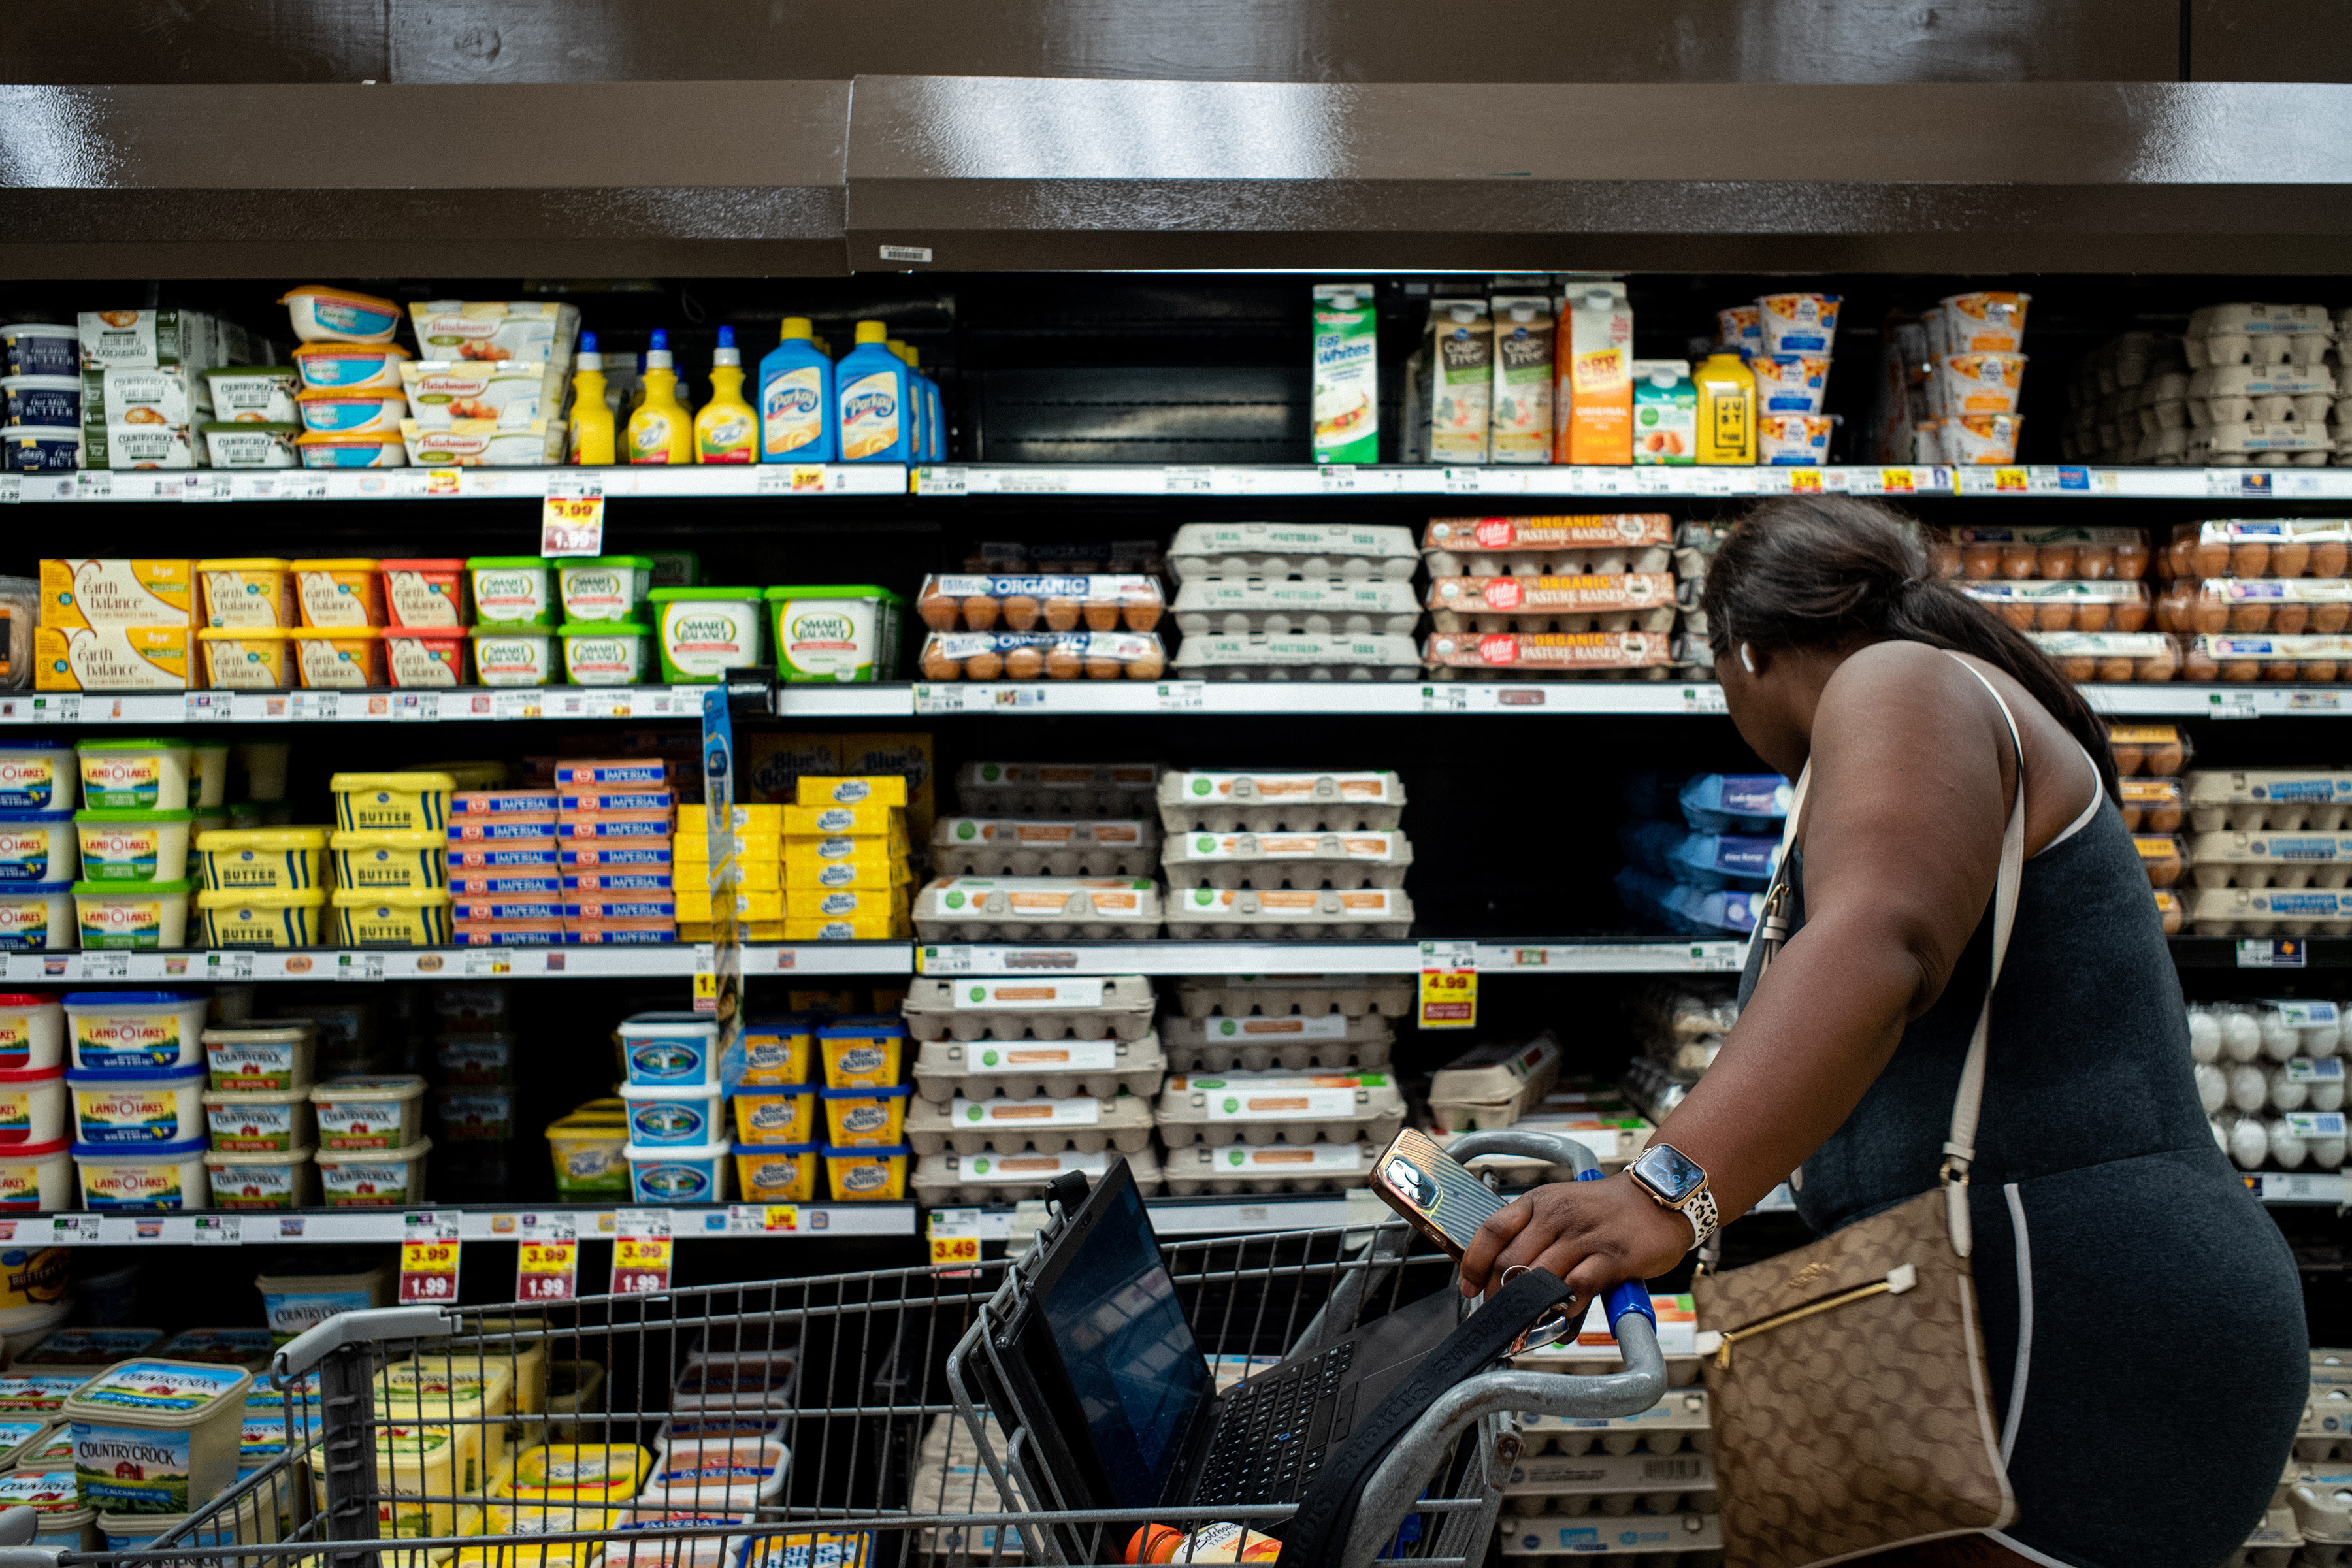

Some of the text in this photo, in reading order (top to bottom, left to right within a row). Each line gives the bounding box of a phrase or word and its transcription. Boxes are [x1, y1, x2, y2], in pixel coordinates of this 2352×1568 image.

[770, 389, 818, 416] Parkay
[845, 394, 896, 417] Parkay
[26, 406, 73, 416] BUTTER
[1531, 516, 1602, 529] ORGANIC
[1516, 528, 1617, 541] PASTURE RAISED
[488, 576, 523, 587] SMART
[576, 575, 612, 585] SMART
[1539, 576, 1610, 589] ORGANIC
[83, 581, 118, 594] earth
[214, 587, 242, 598] earth
[306, 587, 334, 598] earth
[395, 587, 424, 598] earth
[487, 585, 527, 596] BALANCE
[574, 585, 614, 595] BALANCE
[996, 578, 1086, 595] ORGANIC
[91, 595, 142, 609] balance
[1525, 589, 1626, 603] PASTURE RAISED
[221, 599, 261, 610] balance
[312, 598, 354, 610] balance
[402, 598, 444, 610] balance
[683, 620, 725, 631] SMART
[801, 619, 843, 630] SMART
[681, 629, 730, 641] BALANCE
[799, 629, 846, 640] BALANCE
[78, 649, 113, 662] earth
[86, 663, 138, 677] balance
[18, 767, 46, 779] LAKES
[87, 767, 110, 779] LAND
[127, 767, 152, 779] LAKES
[605, 768, 654, 779] IMPERIAL
[500, 798, 551, 809] IMPERIAL
[610, 795, 661, 807] IMPERIAL
[359, 811, 412, 823] BUTTER
[86, 840, 109, 850] LAND
[126, 840, 150, 851] LAKES
[610, 850, 660, 862] IMPERIAL
[223, 869, 276, 881] BUTTER
[502, 906, 551, 917] IMPERIAL
[613, 905, 662, 916] IMPERIAL
[222, 928, 274, 939] BUTTER
[359, 926, 412, 938] BUTTER
[1429, 976, 1467, 988] 4.99
[0, 1030, 16, 1041] KES
[90, 1028, 118, 1039] LAND
[137, 1028, 166, 1039] LAKES
[756, 1045, 777, 1056] Blue
[851, 1049, 873, 1060] Blue
[90, 1102, 116, 1113] LAND
[137, 1102, 163, 1113] LAKES
[761, 1106, 783, 1118] Blue
[853, 1168, 877, 1179] Blue
[0, 1179, 26, 1189] AKES
[411, 1247, 449, 1261] 3.99
[528, 1249, 566, 1262] 3.99
[624, 1245, 661, 1258] 3.99
[935, 1241, 976, 1258] 3.49
[412, 1277, 447, 1296] 1.99
[529, 1278, 564, 1296] 1.99
[623, 1275, 659, 1291] 1.99
[79, 1441, 177, 1467] COUNTRY CROCK
[1182, 1523, 1238, 1554] Bolthous
[1209, 1529, 1239, 1546] FARMS
